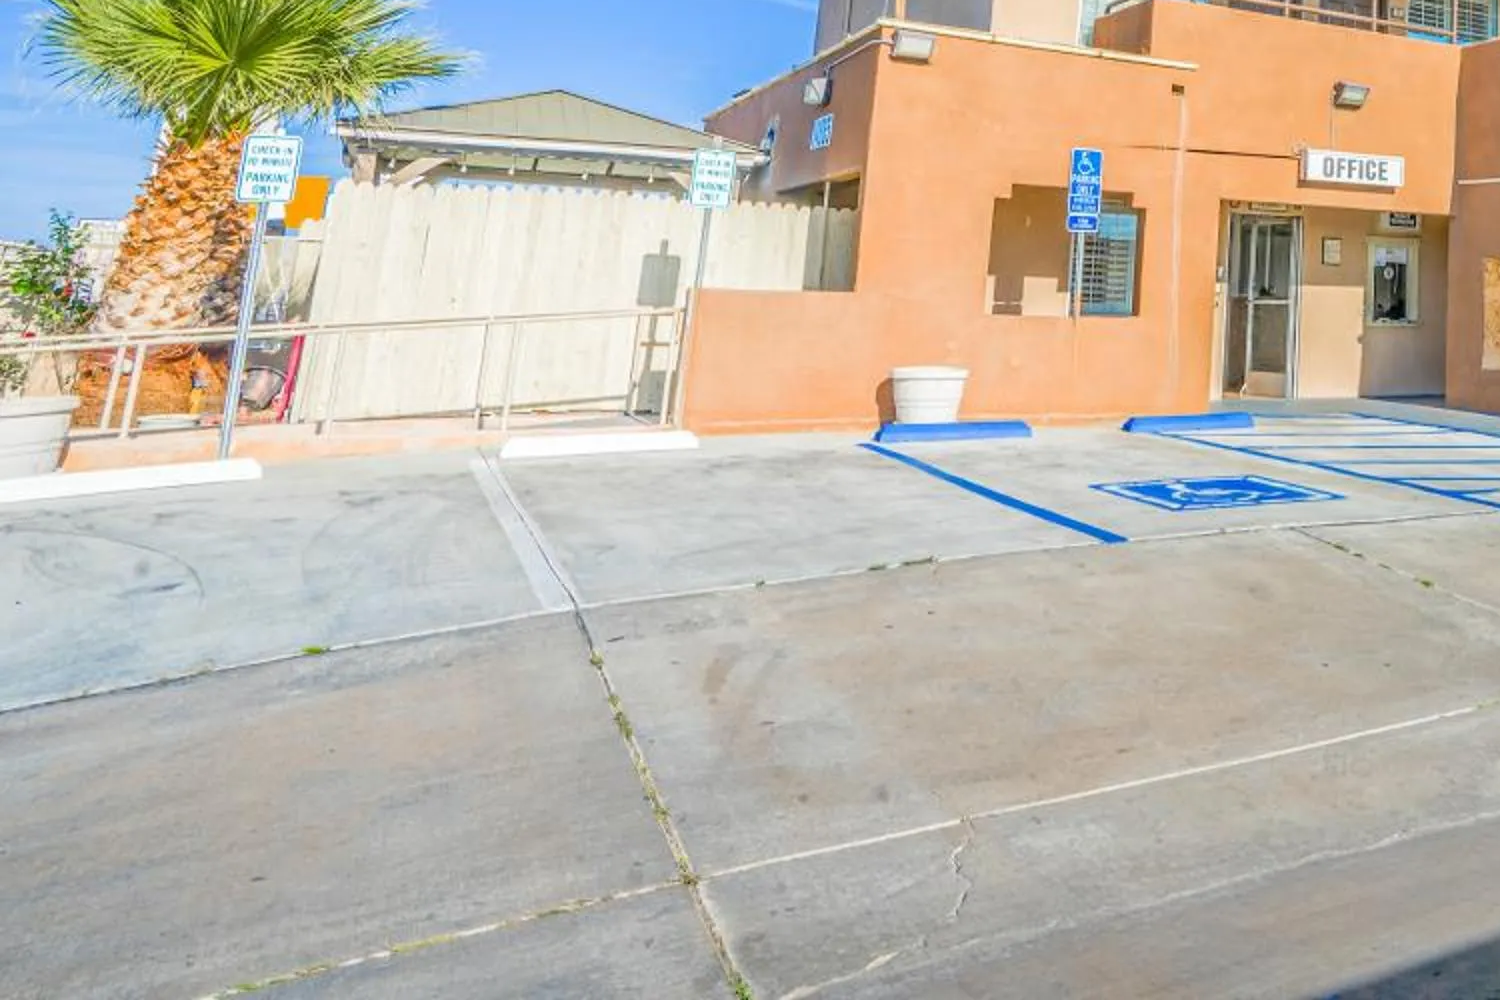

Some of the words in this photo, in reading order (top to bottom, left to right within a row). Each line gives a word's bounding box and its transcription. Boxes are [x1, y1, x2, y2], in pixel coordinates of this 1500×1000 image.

[1322, 157, 1389, 181] OFFICE
[245, 171, 290, 184] PARKING
[1071, 173, 1101, 184] PARKING
[251, 184, 281, 196] ONLY
